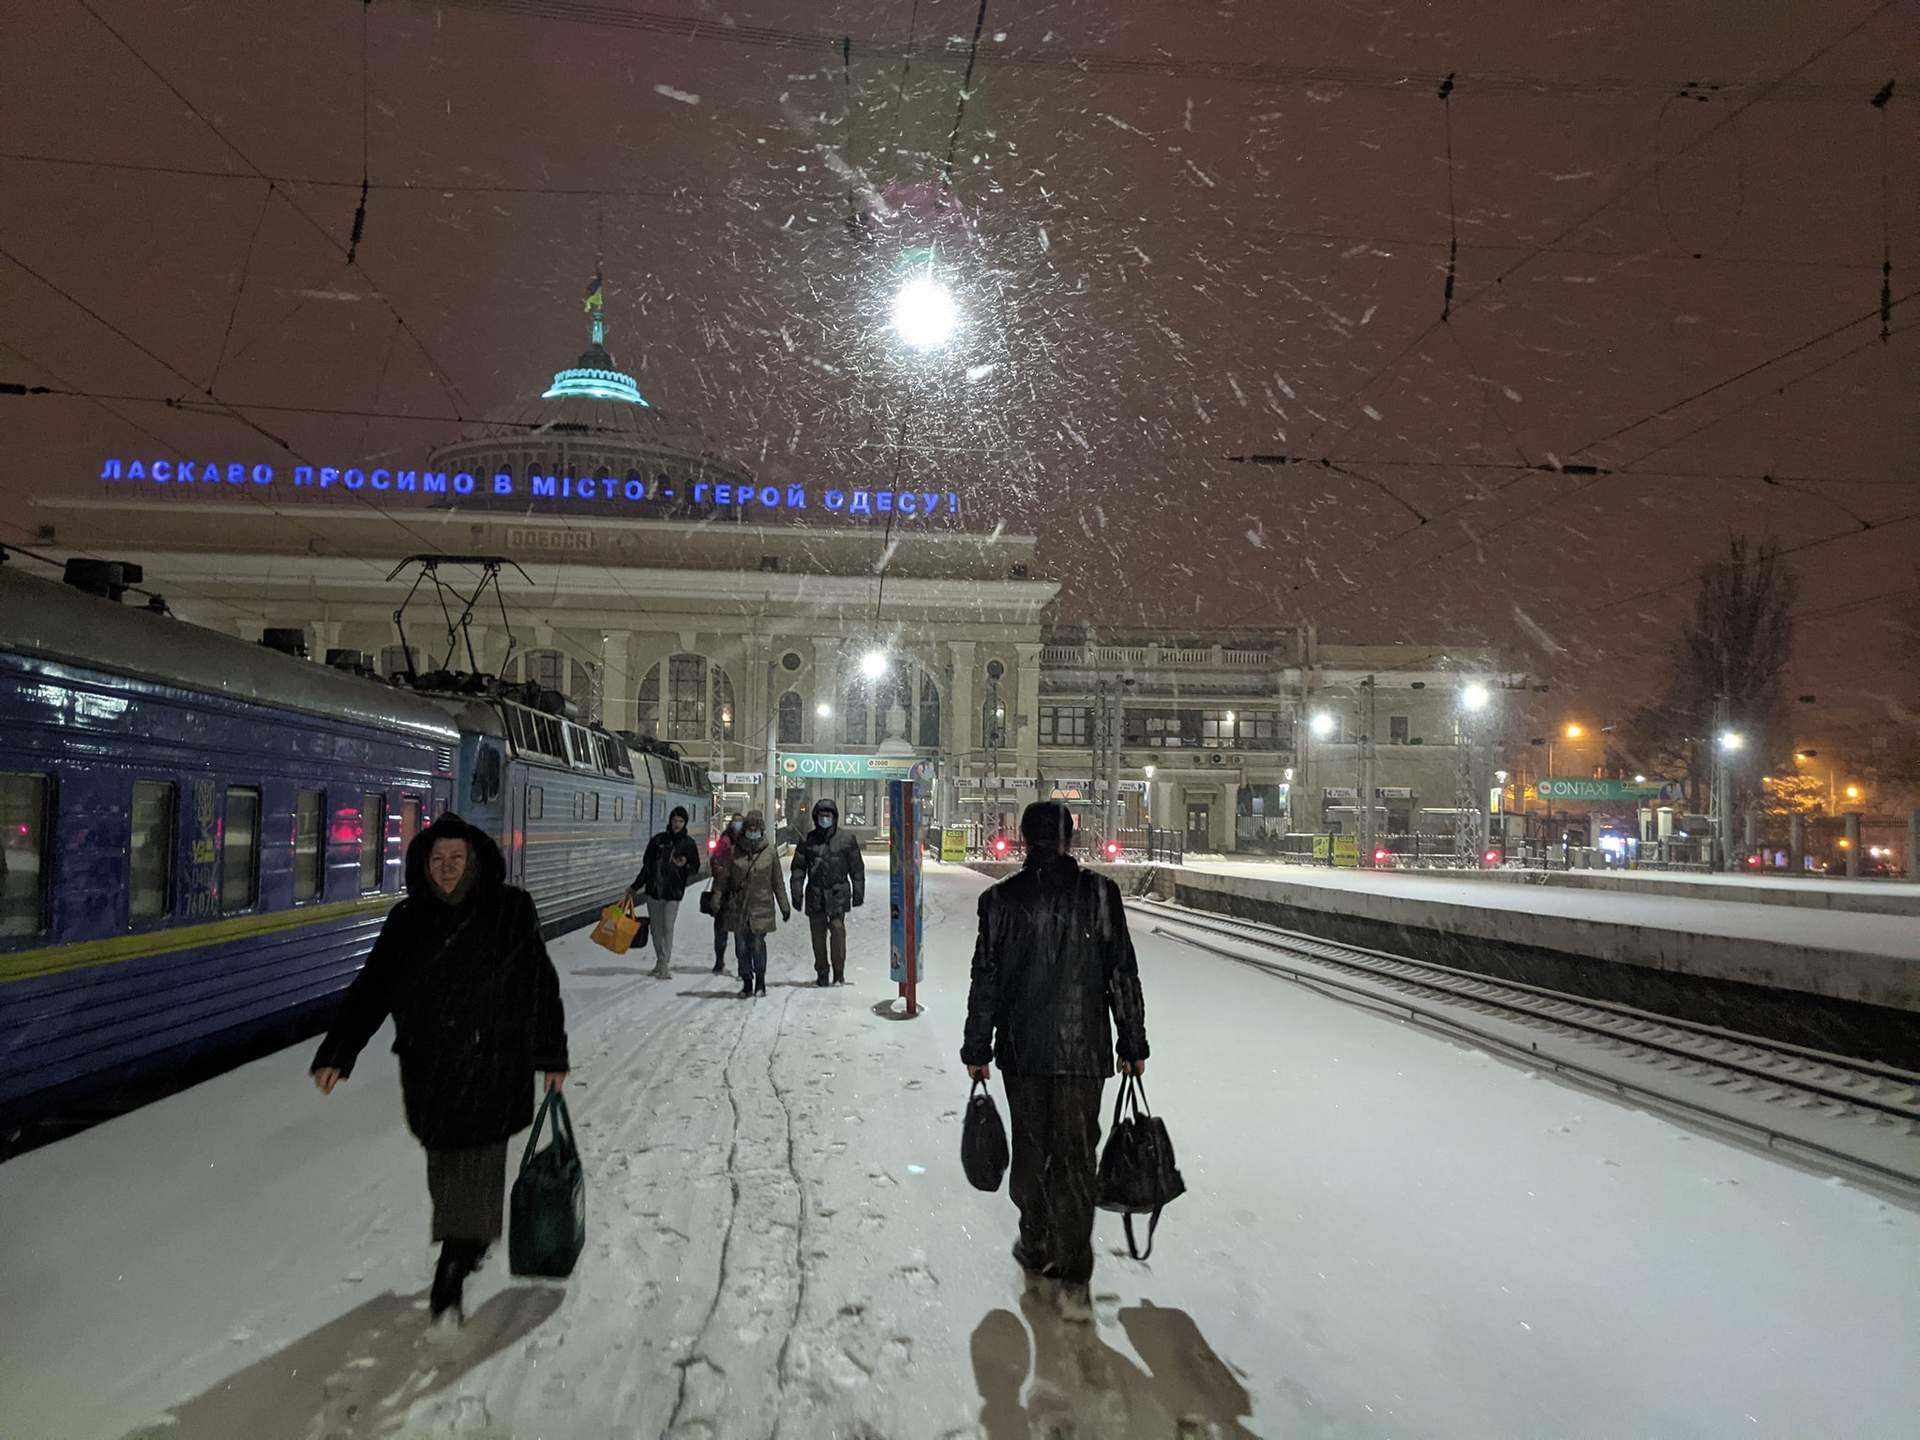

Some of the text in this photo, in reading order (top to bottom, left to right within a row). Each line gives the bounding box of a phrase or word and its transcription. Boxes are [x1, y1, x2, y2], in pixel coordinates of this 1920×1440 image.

[100, 458, 274, 485] ЛАСКАВО
[293, 465, 476, 495] ПРОСИМО
[494, 473, 514, 496] В
[531, 475, 646, 501] МІСТО
[693, 482, 807, 511] ГЕРОЙ
[823, 488, 958, 516] ОДЕСУ!
[800, 759, 860, 774] ONTAXI
[1554, 781, 1609, 796] ONTAXI
